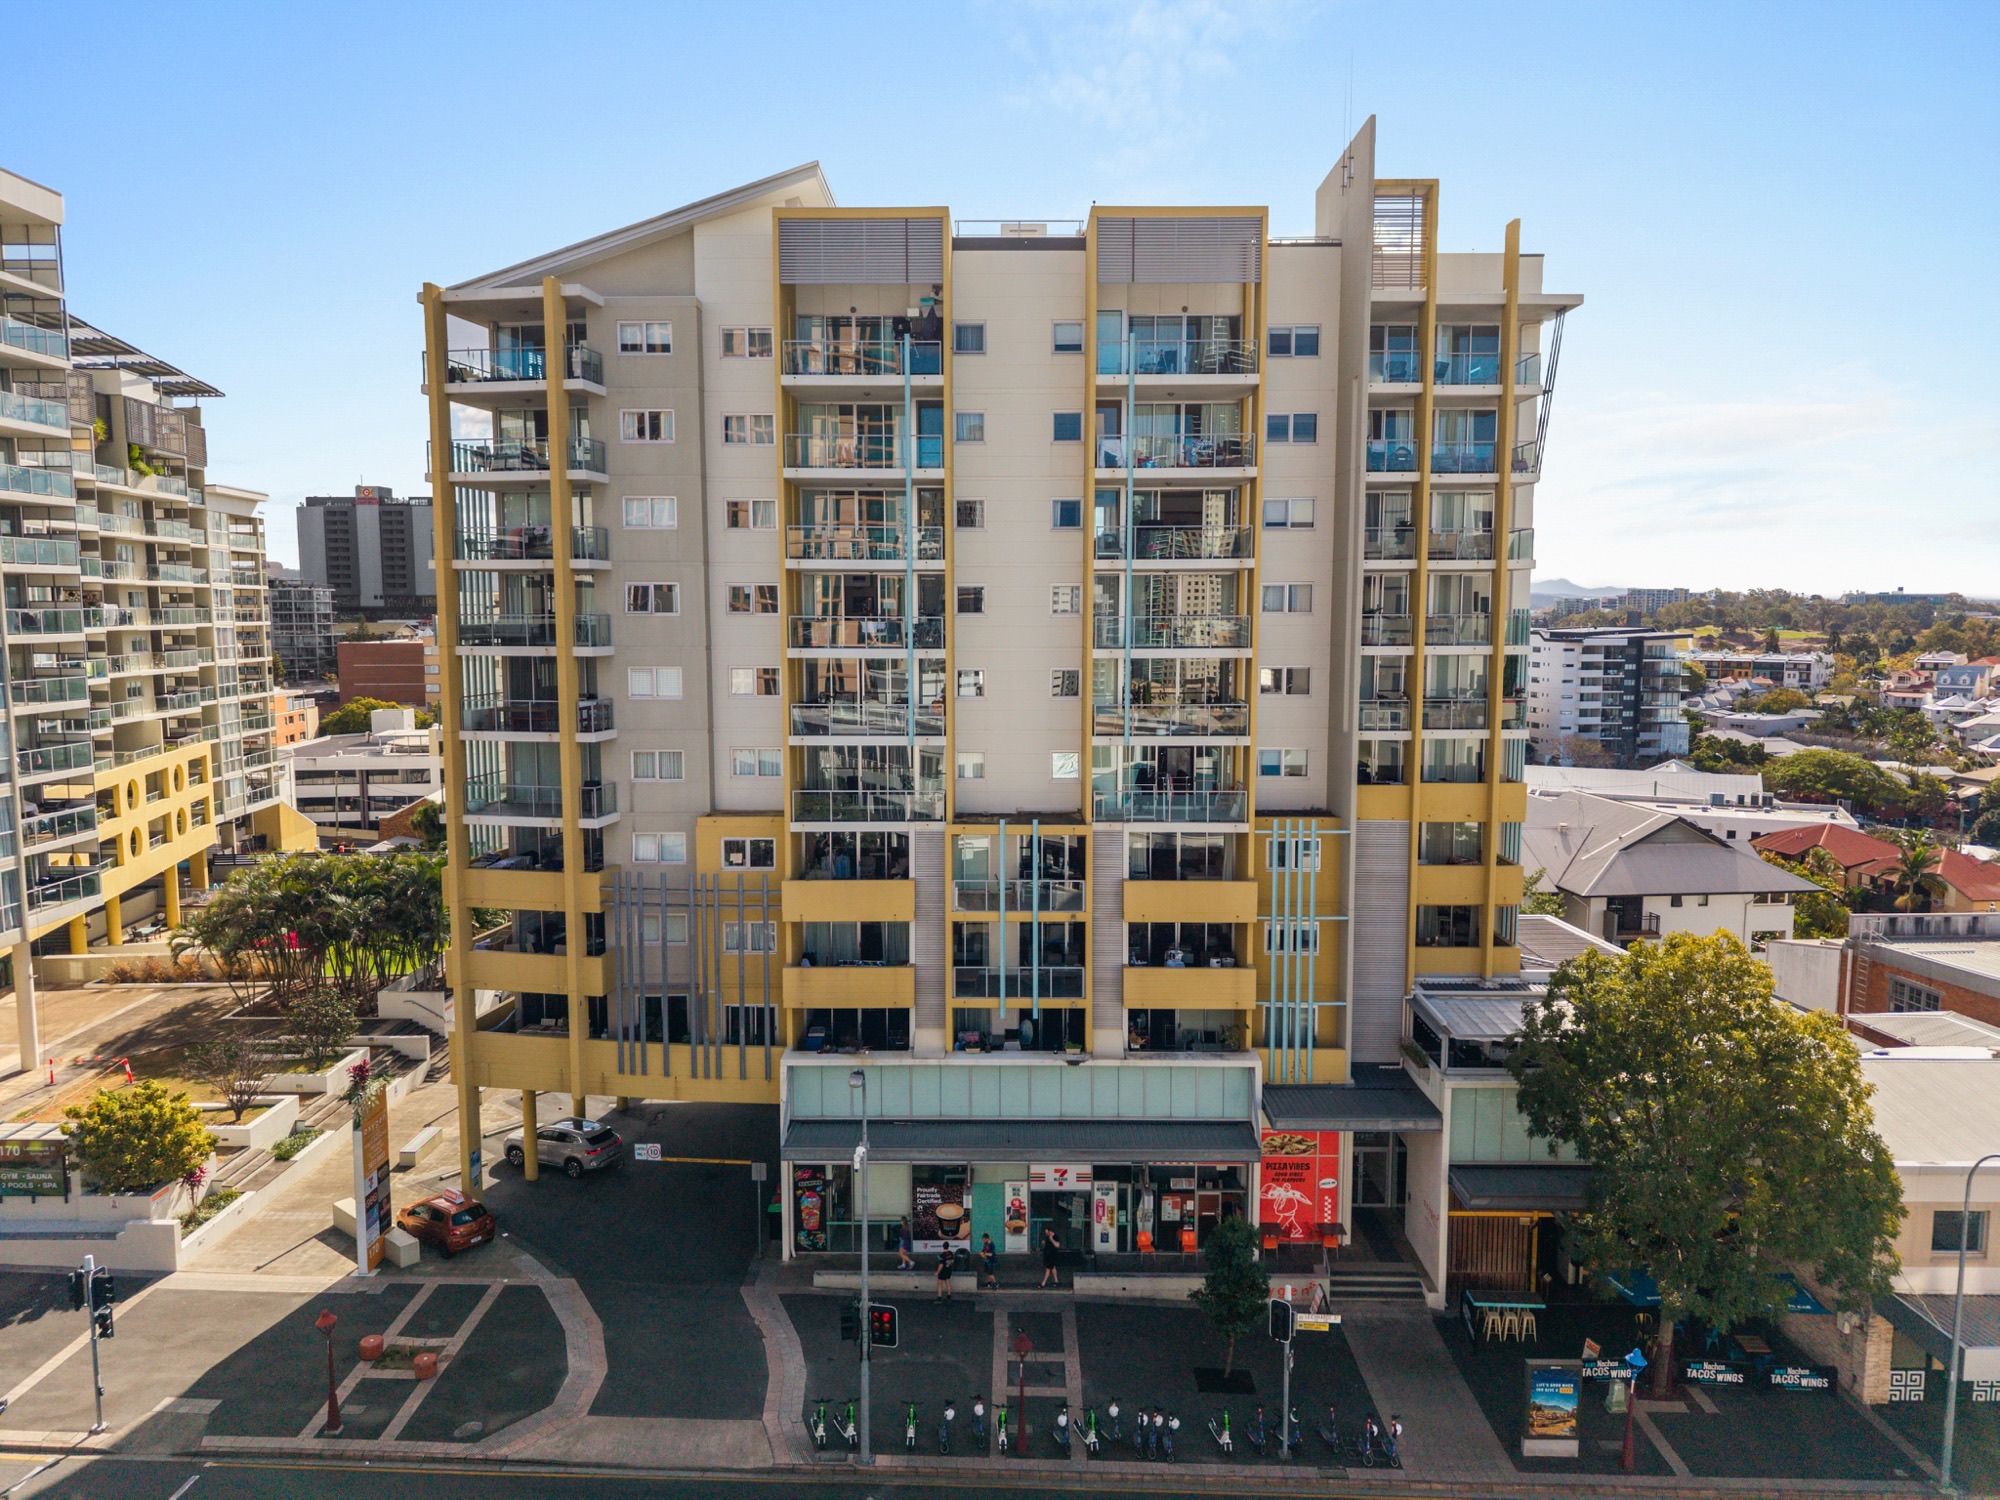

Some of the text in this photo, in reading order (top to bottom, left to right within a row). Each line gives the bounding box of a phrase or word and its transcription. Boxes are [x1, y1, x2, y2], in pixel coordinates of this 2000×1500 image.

[0, 1145, 20, 1156] 170
[1265, 1162, 1311, 1171] PIZZA VIBES
[1703, 1362, 1725, 1370] Nachos
[1787, 1367, 1810, 1375] Nachos
[1582, 1367, 1632, 1378] TACOS WING
[1687, 1368, 1744, 1383] TACOS WINGS
[1770, 1374, 1829, 1387] TACOS WINGS
